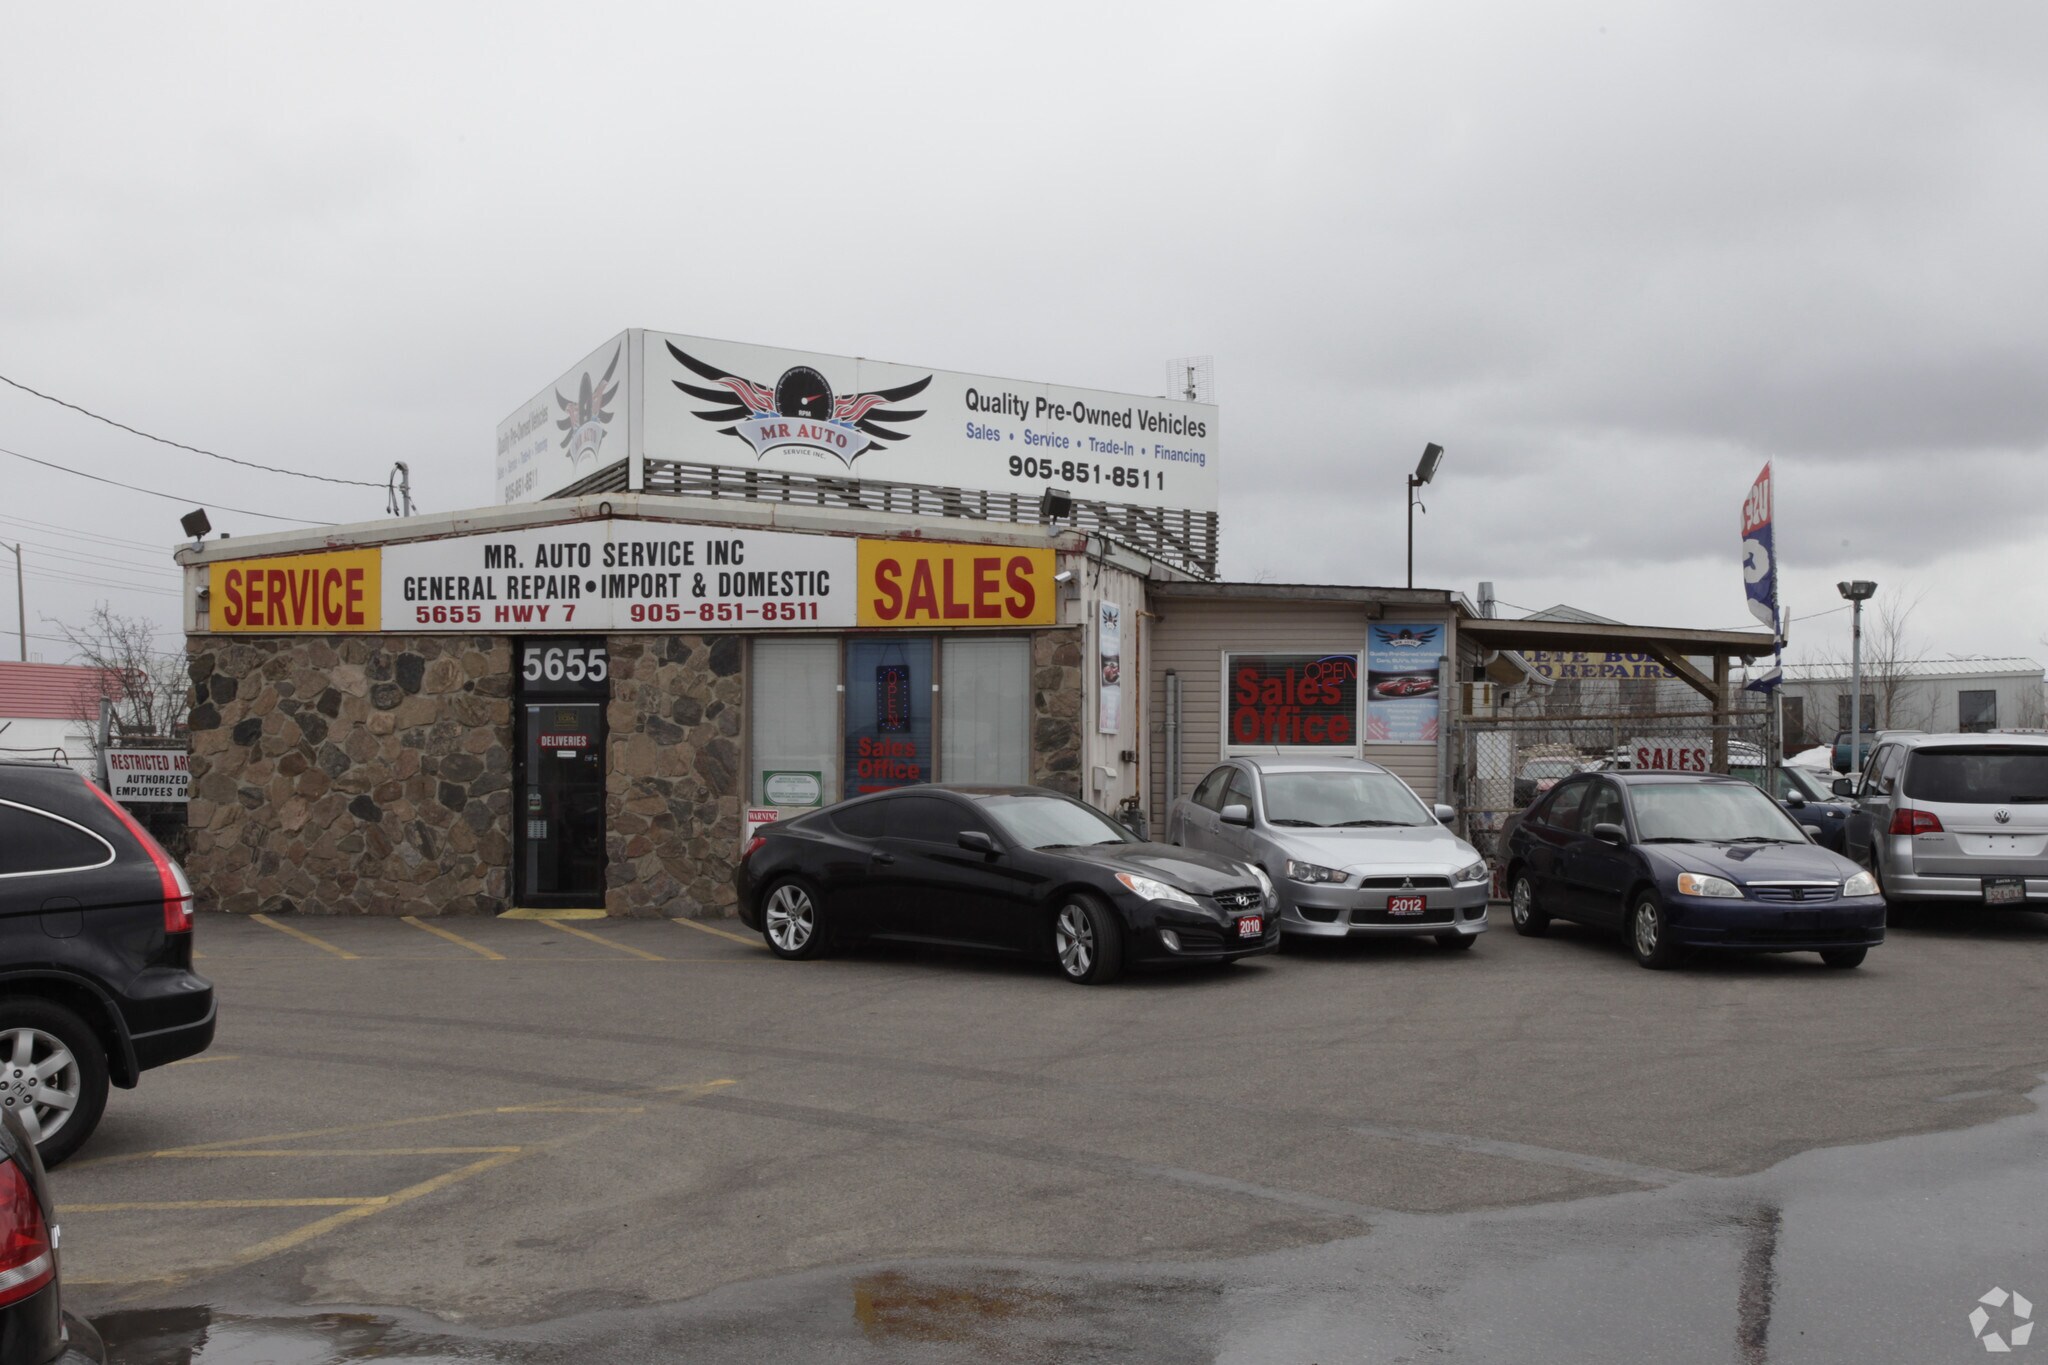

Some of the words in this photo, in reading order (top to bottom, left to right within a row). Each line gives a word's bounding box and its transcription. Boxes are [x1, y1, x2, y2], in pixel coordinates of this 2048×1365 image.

[965, 387, 1029, 421] Quality
[1035, 396, 1132, 429] Pre-Owned
[1137, 409, 1206, 438] Vehicles
[760, 423, 791, 441] MR
[797, 423, 848, 448] AUTO
[966, 422, 1000, 442] Sales
[1024, 429, 1070, 449] Service
[1088, 437, 1134, 457] Trade-In
[1154, 444, 1206, 467] Financing
[1008, 455, 1164, 491] 905-851-8511
[484, 544, 524, 569] MR.
[535, 542, 591, 568] AUTO
[602, 541, 695, 567] SERVICE
[707, 539, 744, 566] INC
[224, 568, 364, 627] SERVICE
[404, 575, 497, 601] GENERAL
[507, 574, 581, 600] REPAIR
[601, 572, 681, 599] IMPORT
[692, 572, 707, 598] &
[719, 570, 830, 598] DOMESTIC
[873, 555, 1036, 621] SALES
[416, 605, 481, 624] 5655
[495, 604, 550, 623] HWY
[562, 604, 576, 622] 7
[630, 601, 818, 622] 905-851-8511
[522, 647, 608, 682] 5655
[1304, 661, 1358, 681] OPEN
[1560, 664, 1679, 679] REPAIRS
[887, 671, 899, 727] OPEN
[1235, 667, 1342, 706] Sales
[1233, 704, 1350, 743] Office
[541, 735, 587, 747] DELIVERIES
[858, 736, 916, 758] Sales
[110, 754, 170, 771] RESTRICTED
[857, 758, 921, 779] Office
[1636, 747, 1706, 772] SALES
[116, 786, 173, 797] EMPLOYEES
[126, 774, 188, 784] AUTHORIZED
[749, 811, 777, 821] WARNING
[1392, 899, 1422, 911] 2012
[1240, 919, 1260, 934] 2010
